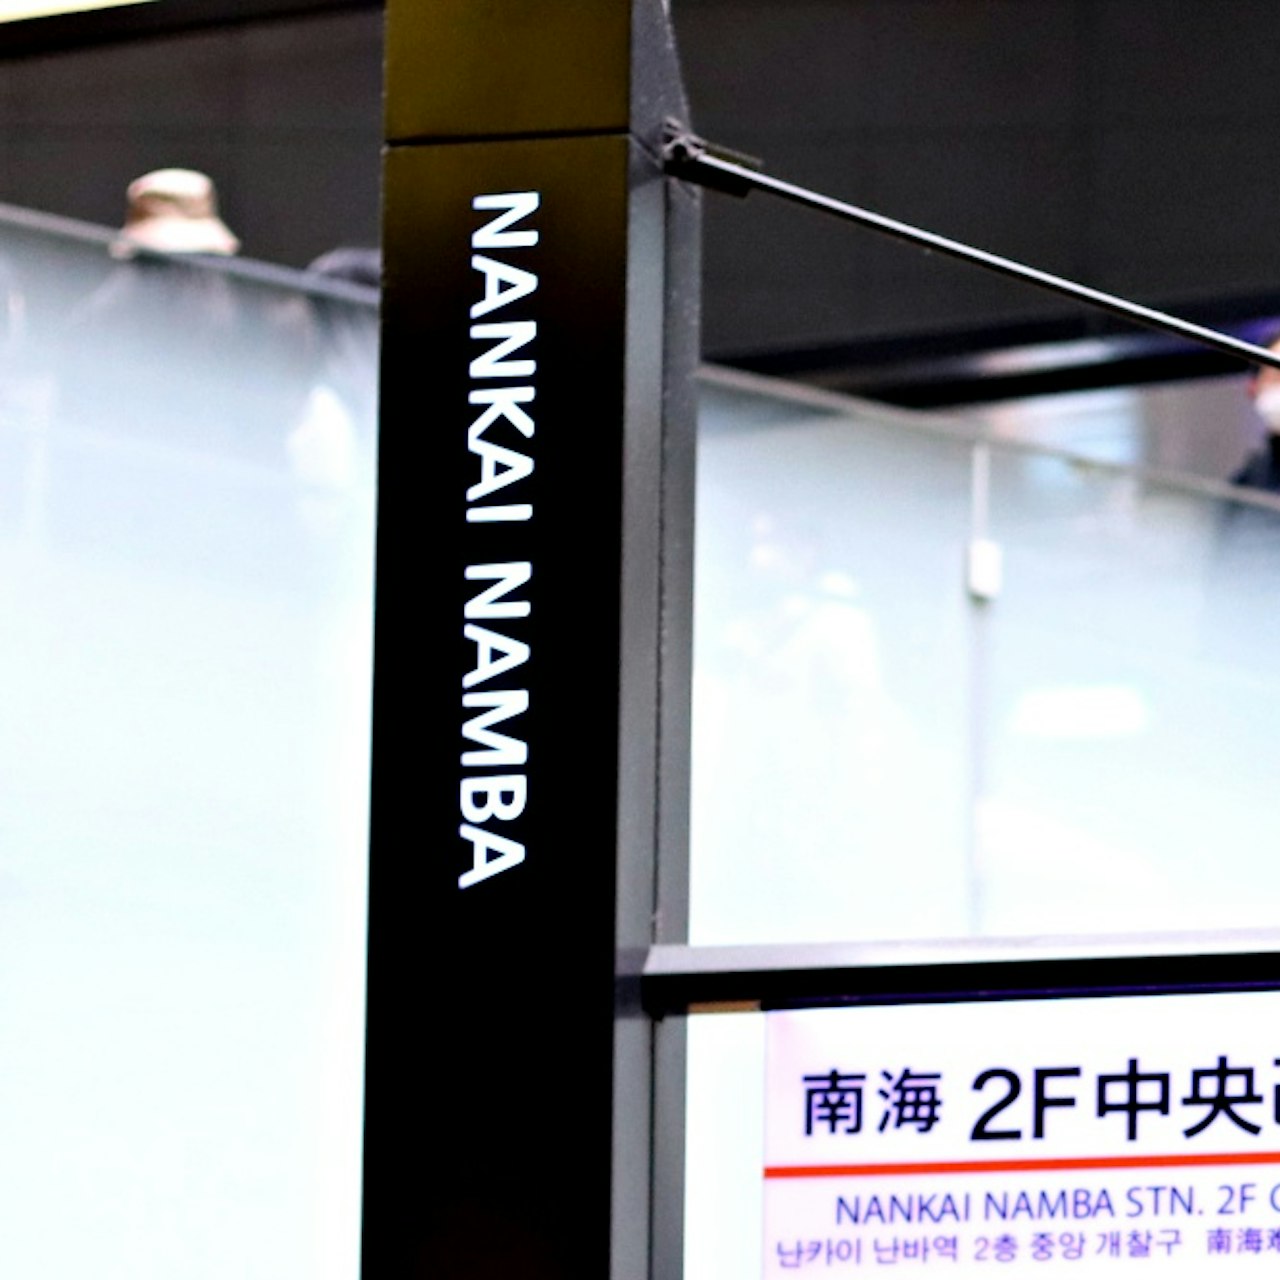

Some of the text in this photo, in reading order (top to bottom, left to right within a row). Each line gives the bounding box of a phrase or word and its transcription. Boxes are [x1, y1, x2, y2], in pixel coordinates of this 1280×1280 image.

[458, 192, 539, 889] NANKAI NAMBA
[802, 1068, 942, 1136] 南海
[836, 1193, 970, 1225] NANKAI
[984, 1188, 1115, 1220] NAMBA
[1126, 1186, 1203, 1218] STN.
[1217, 1183, 1256, 1215] 2F
[776, 1229, 1182, 1269] 난카이 난바역 2층 중앙 개찰구
